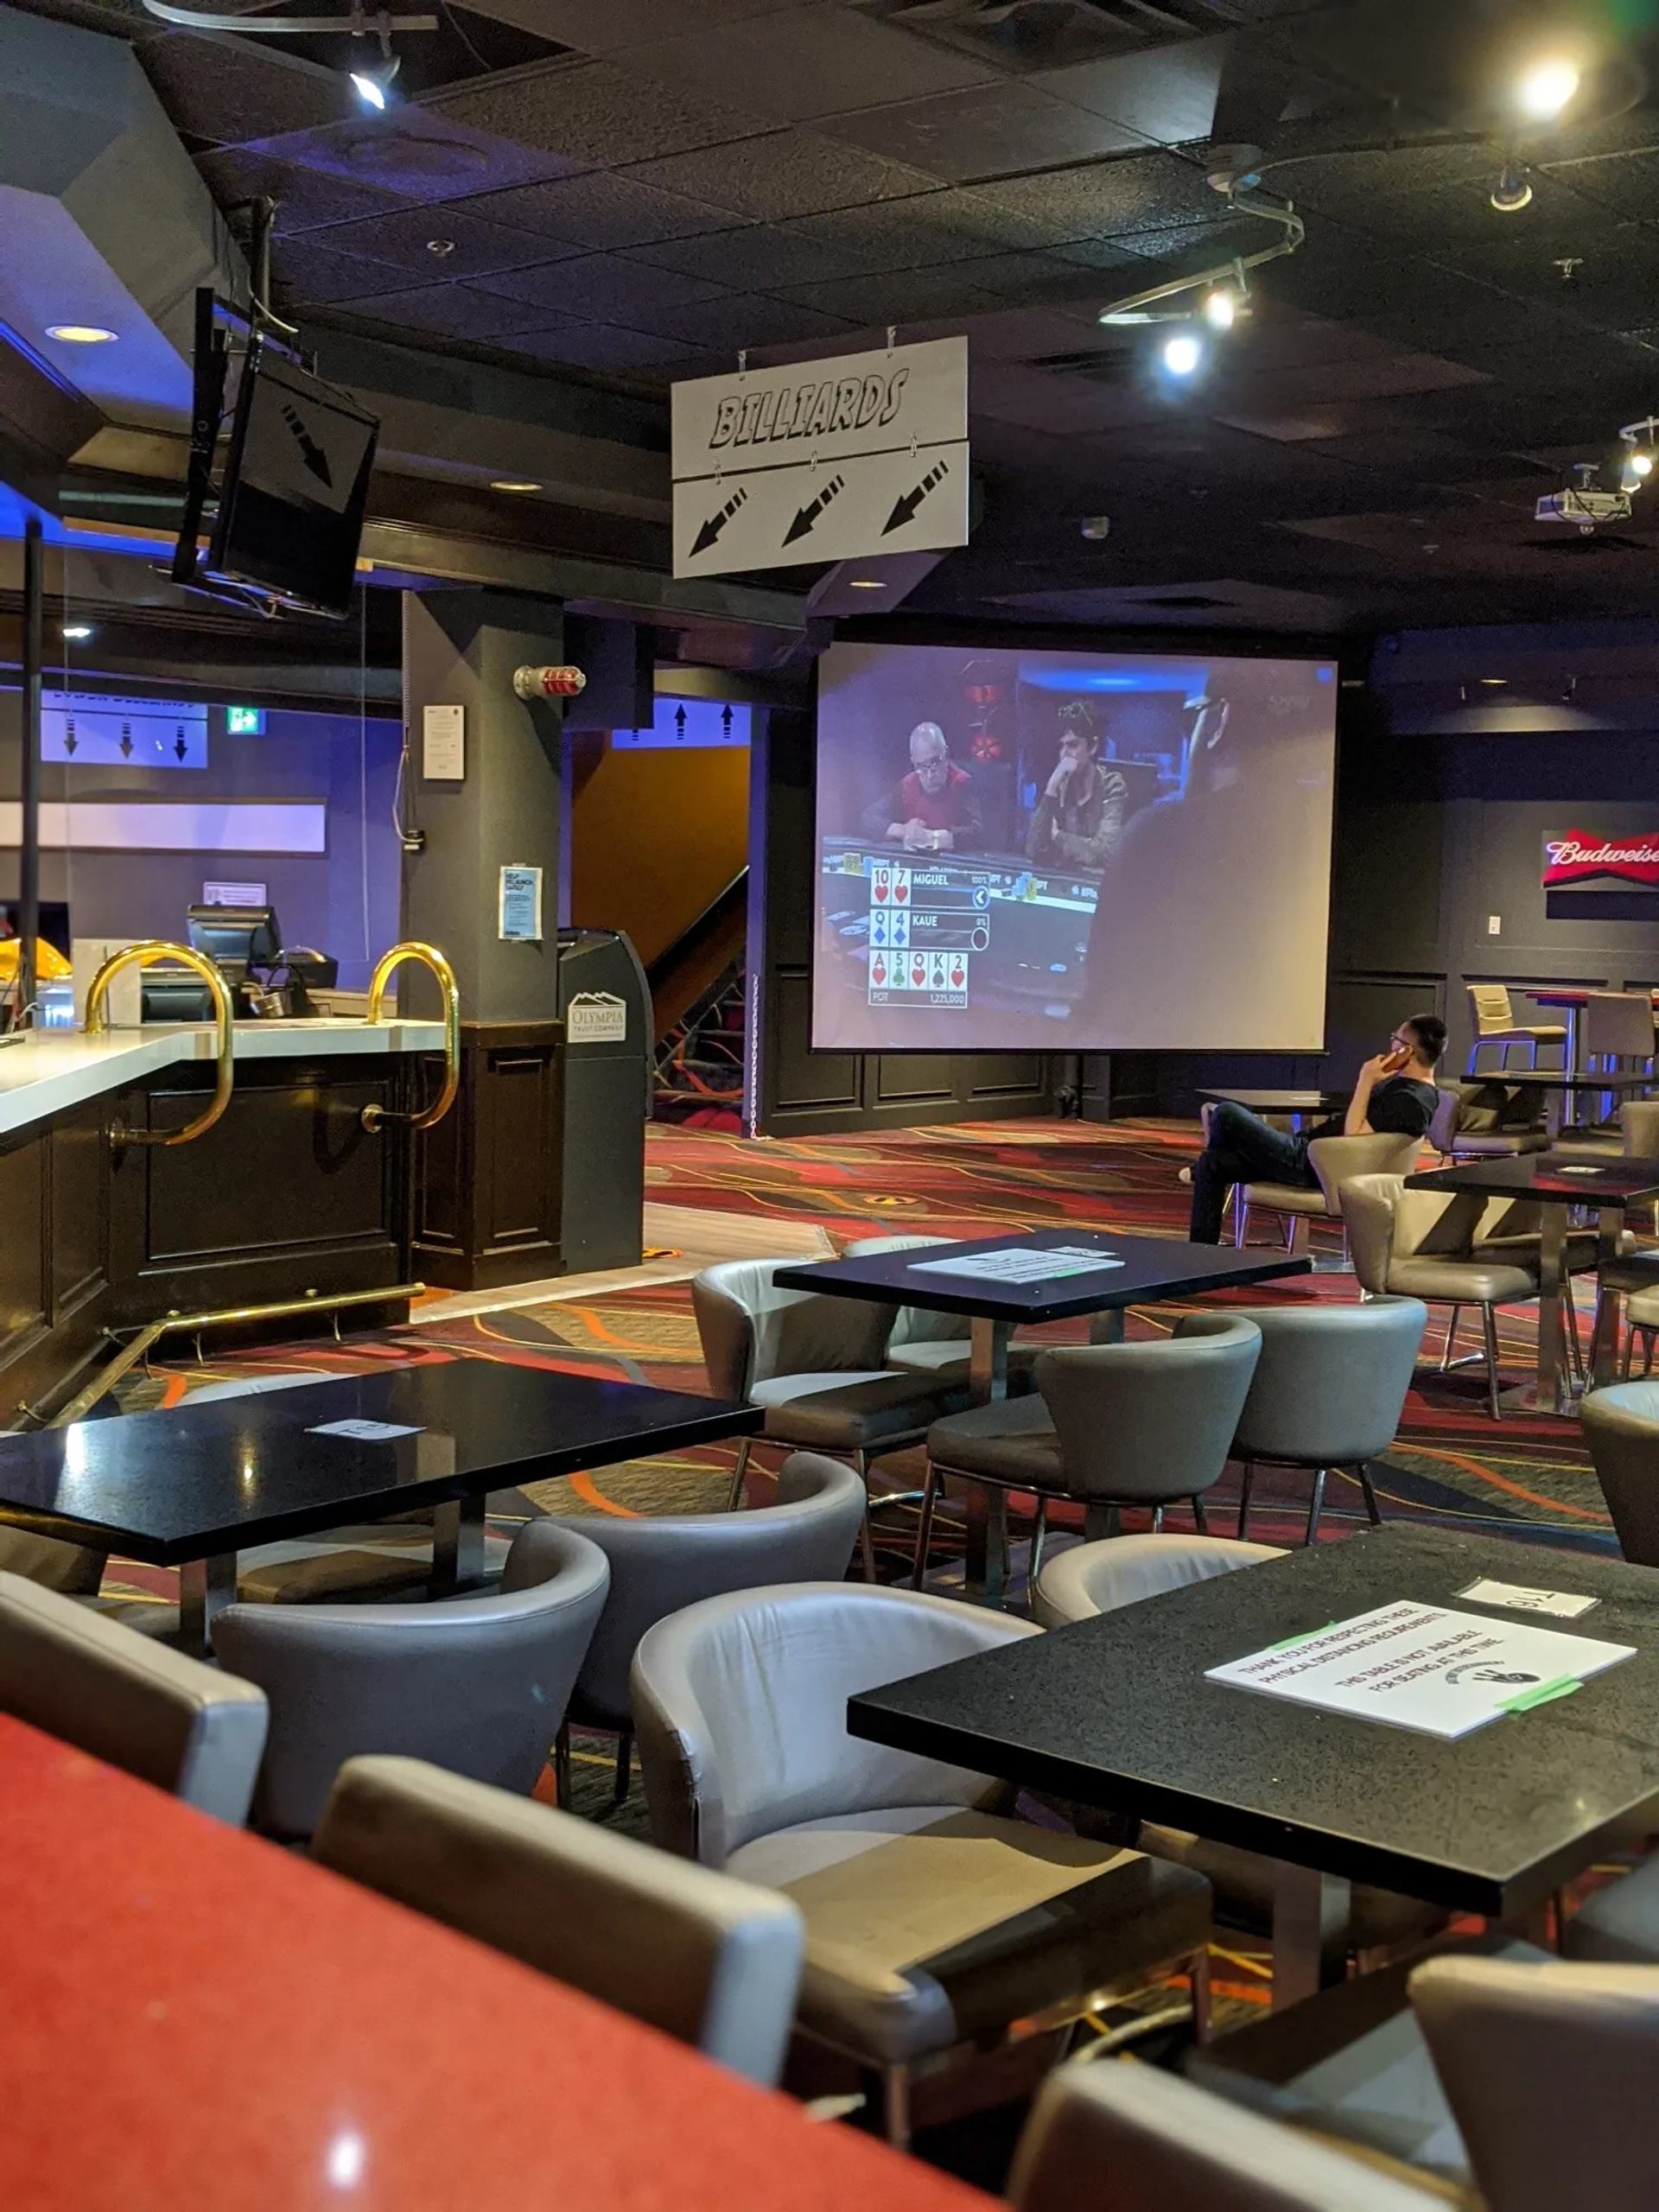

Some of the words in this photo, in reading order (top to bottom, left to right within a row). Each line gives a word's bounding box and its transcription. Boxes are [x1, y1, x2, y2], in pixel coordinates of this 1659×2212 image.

[709, 367, 909, 449] BILLIARDS
[875, 869, 888, 884] 10
[898, 869, 906, 884] 7
[913, 874, 949, 886] MIGUEL
[874, 912, 885, 925] Q
[896, 912, 905, 926] 4
[912, 915, 938, 926] KAUE
[976, 918, 986, 926] 0%
[874, 952, 885, 966] A
[896, 952, 903, 966] 5
[914, 953, 925, 968] Q
[934, 954, 943, 969] K
[955, 955, 962, 969] 2
[873, 993, 888, 1001] POT
[573, 1010, 623, 1024] OLYMPIA
[1506, 1591, 1556, 1608] T16
[1237, 1657, 1286, 1674] THANK
[1277, 1648, 1309, 1659] YOU
[1301, 1640, 1332, 1651] FOR
[1323, 1618, 1389, 1643] RESPECTING
[1382, 1607, 1420, 1622] THESE
[1258, 1661, 1319, 1684] PHYSICAL
[1310, 1637, 1378, 1664] DISTANCING
[1334, 1674, 1369, 1687] THIS
[1359, 1662, 1402, 1678] TABLE
[1402, 1649, 1433, 1662] NOT
[1427, 1630, 1484, 1651] AVAILABLE
[1368, 1680, 1400, 1693] FOR
[1392, 1663, 1442, 1682] SEATING
[1446, 1647, 1479, 1659] THIS
